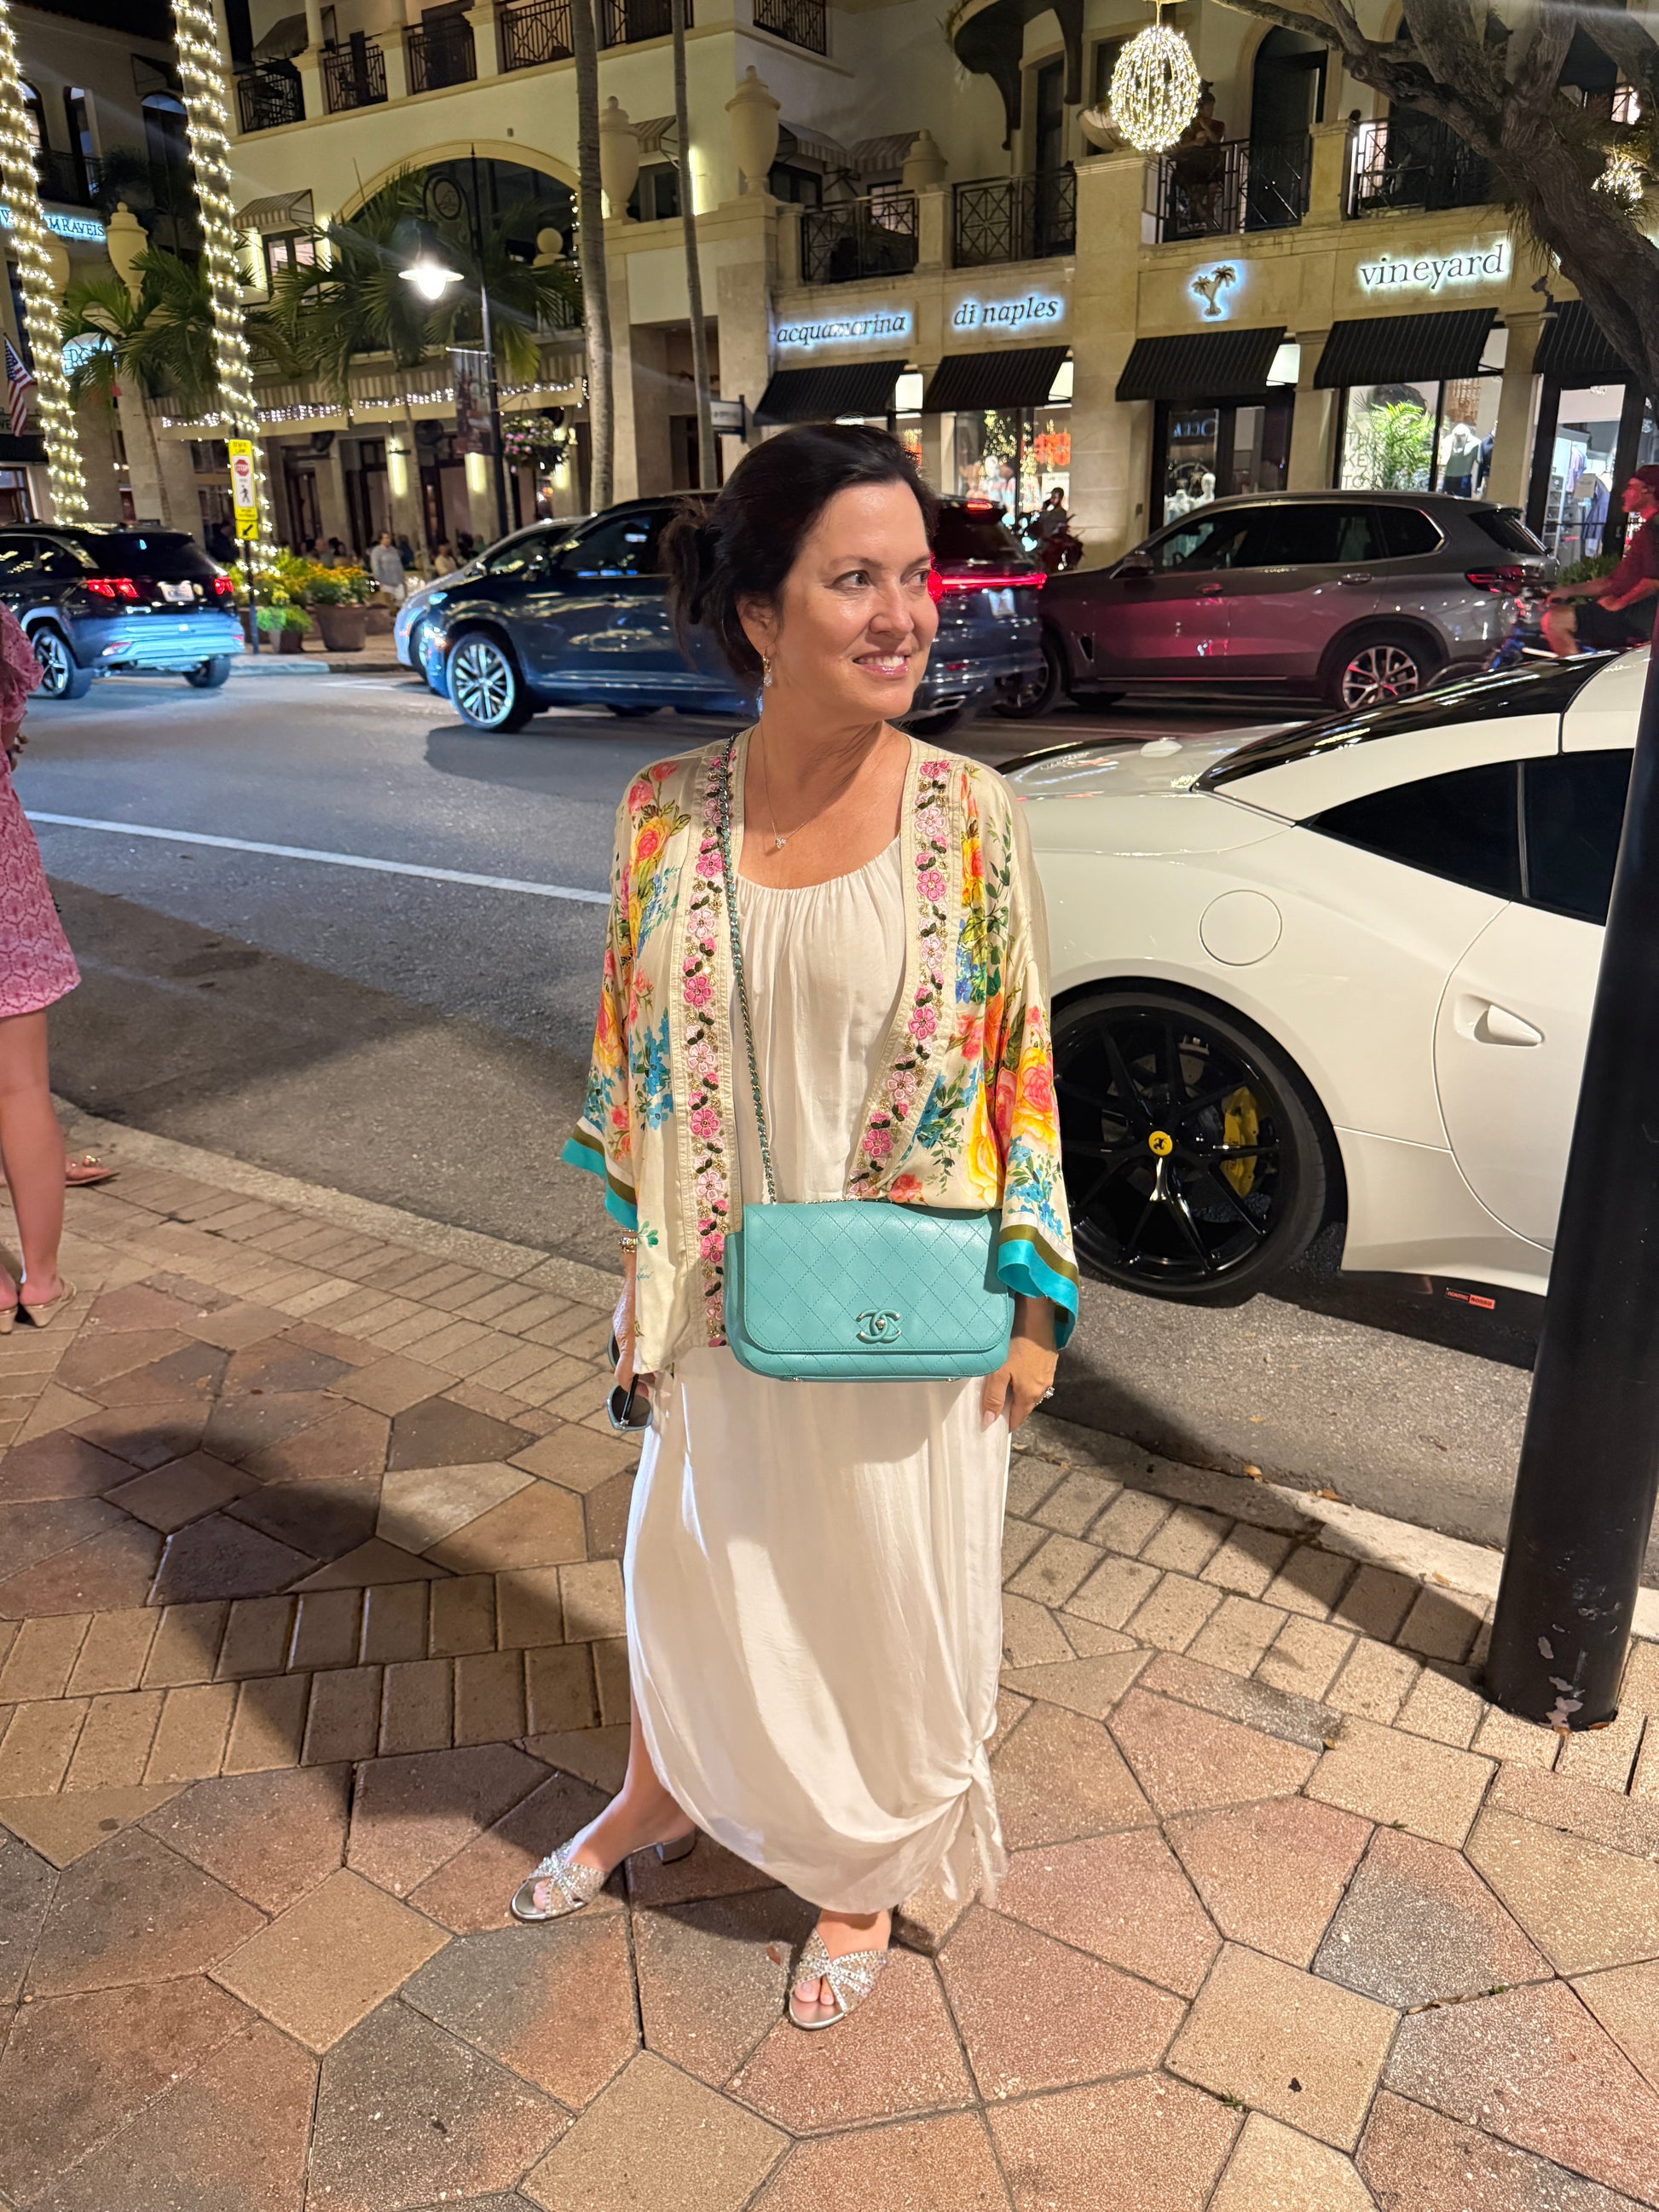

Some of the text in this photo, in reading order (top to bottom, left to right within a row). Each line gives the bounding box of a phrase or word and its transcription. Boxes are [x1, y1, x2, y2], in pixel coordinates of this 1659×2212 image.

[62, 217, 105, 236] RAVEIS
[1360, 244, 1505, 290] vineyard
[954, 296, 1059, 325] di naples
[777, 313, 906, 346] acquamarina
